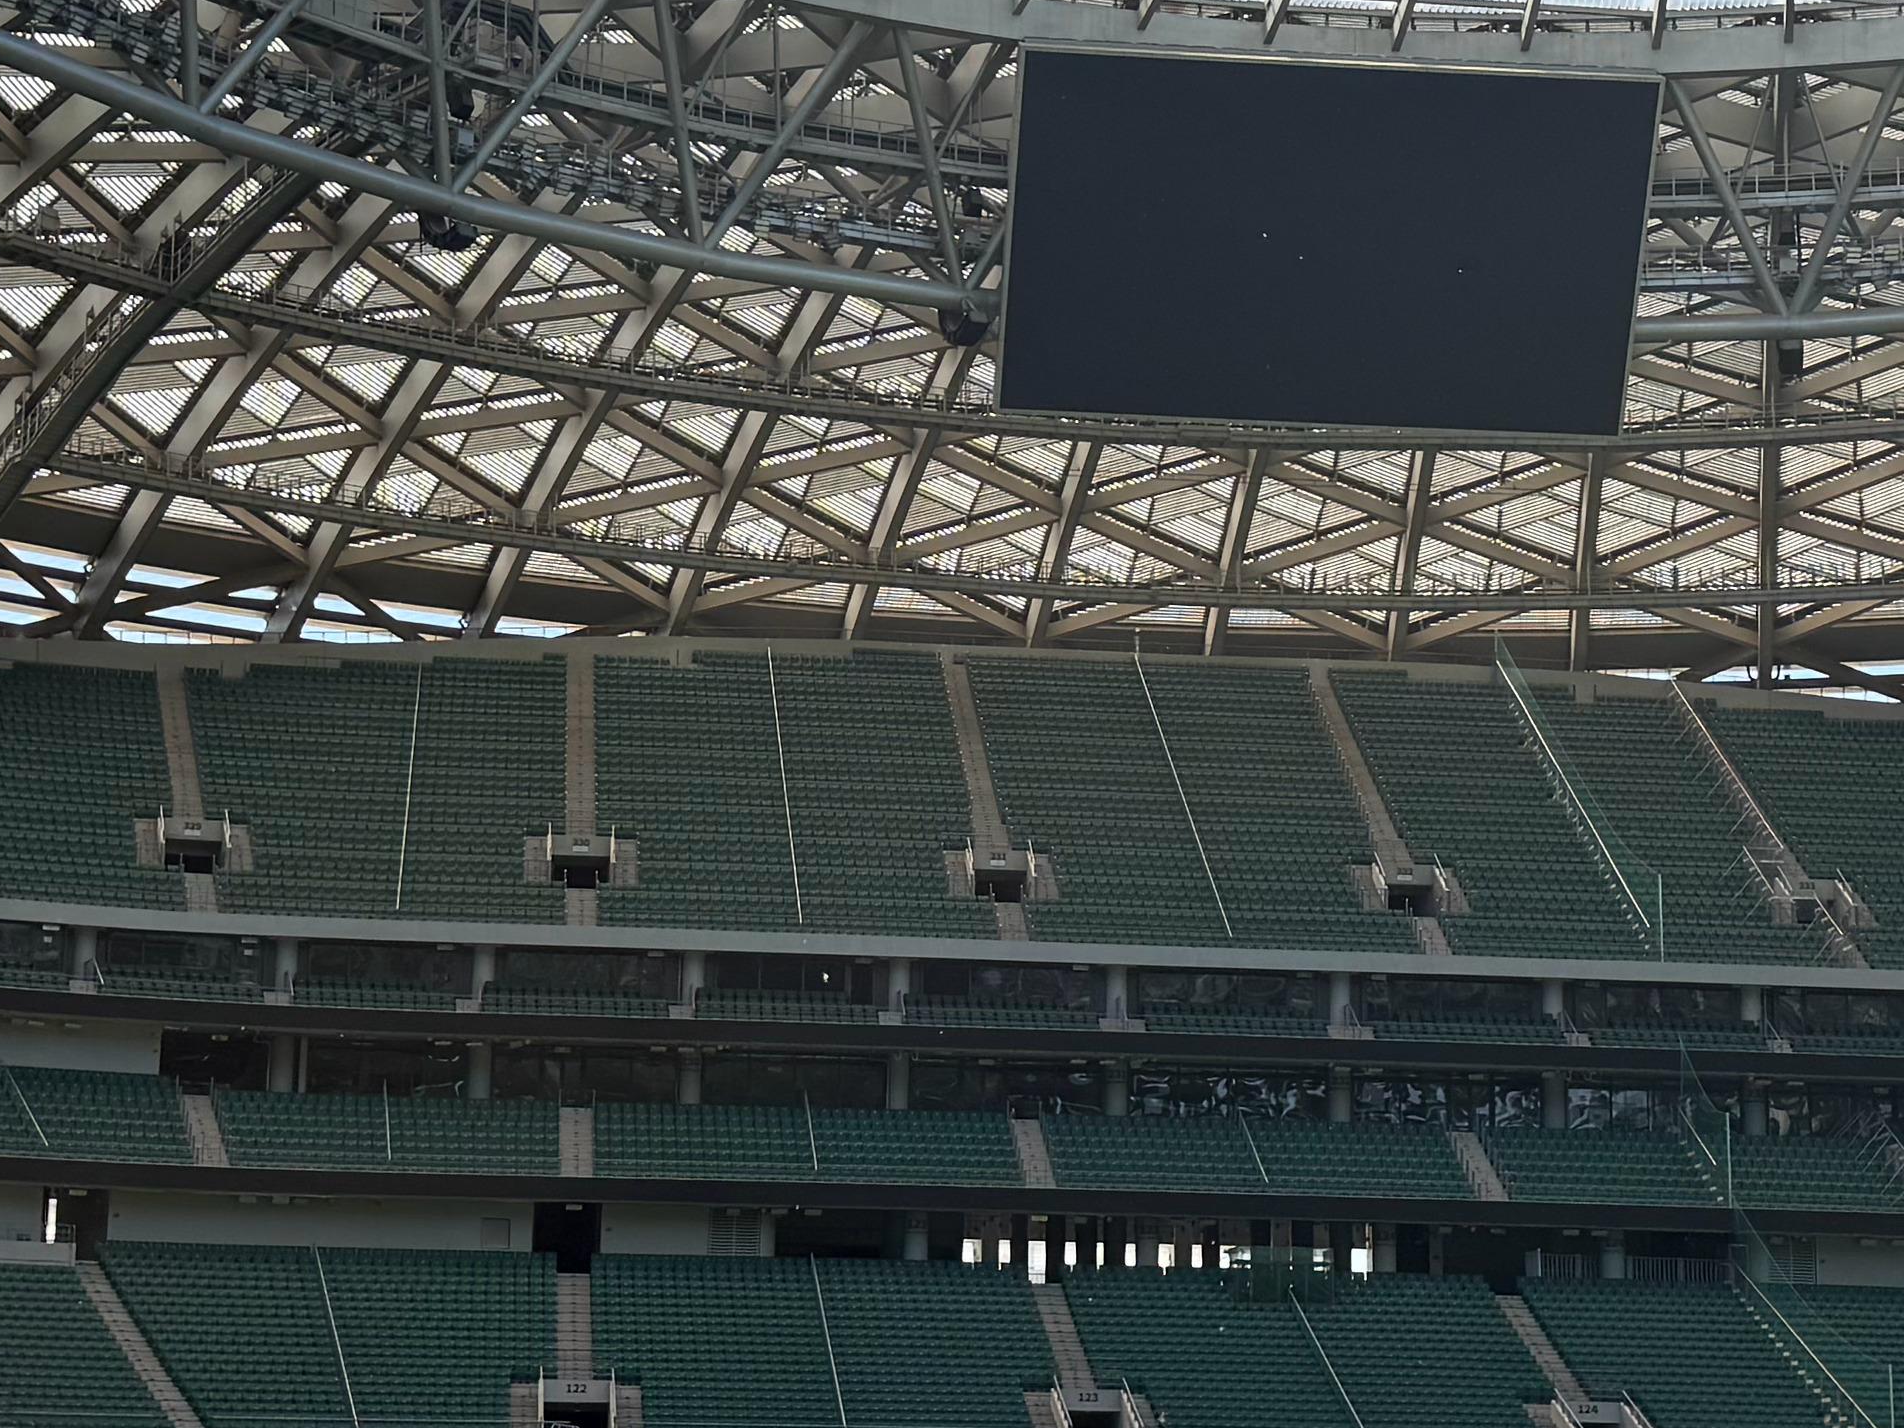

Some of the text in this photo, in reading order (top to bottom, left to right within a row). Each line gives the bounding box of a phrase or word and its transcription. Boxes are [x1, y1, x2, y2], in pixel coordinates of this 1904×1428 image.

[566, 1383, 588, 1394] 122
[1078, 1392, 1098, 1402] 123
[1578, 1404, 1599, 1414] 124
